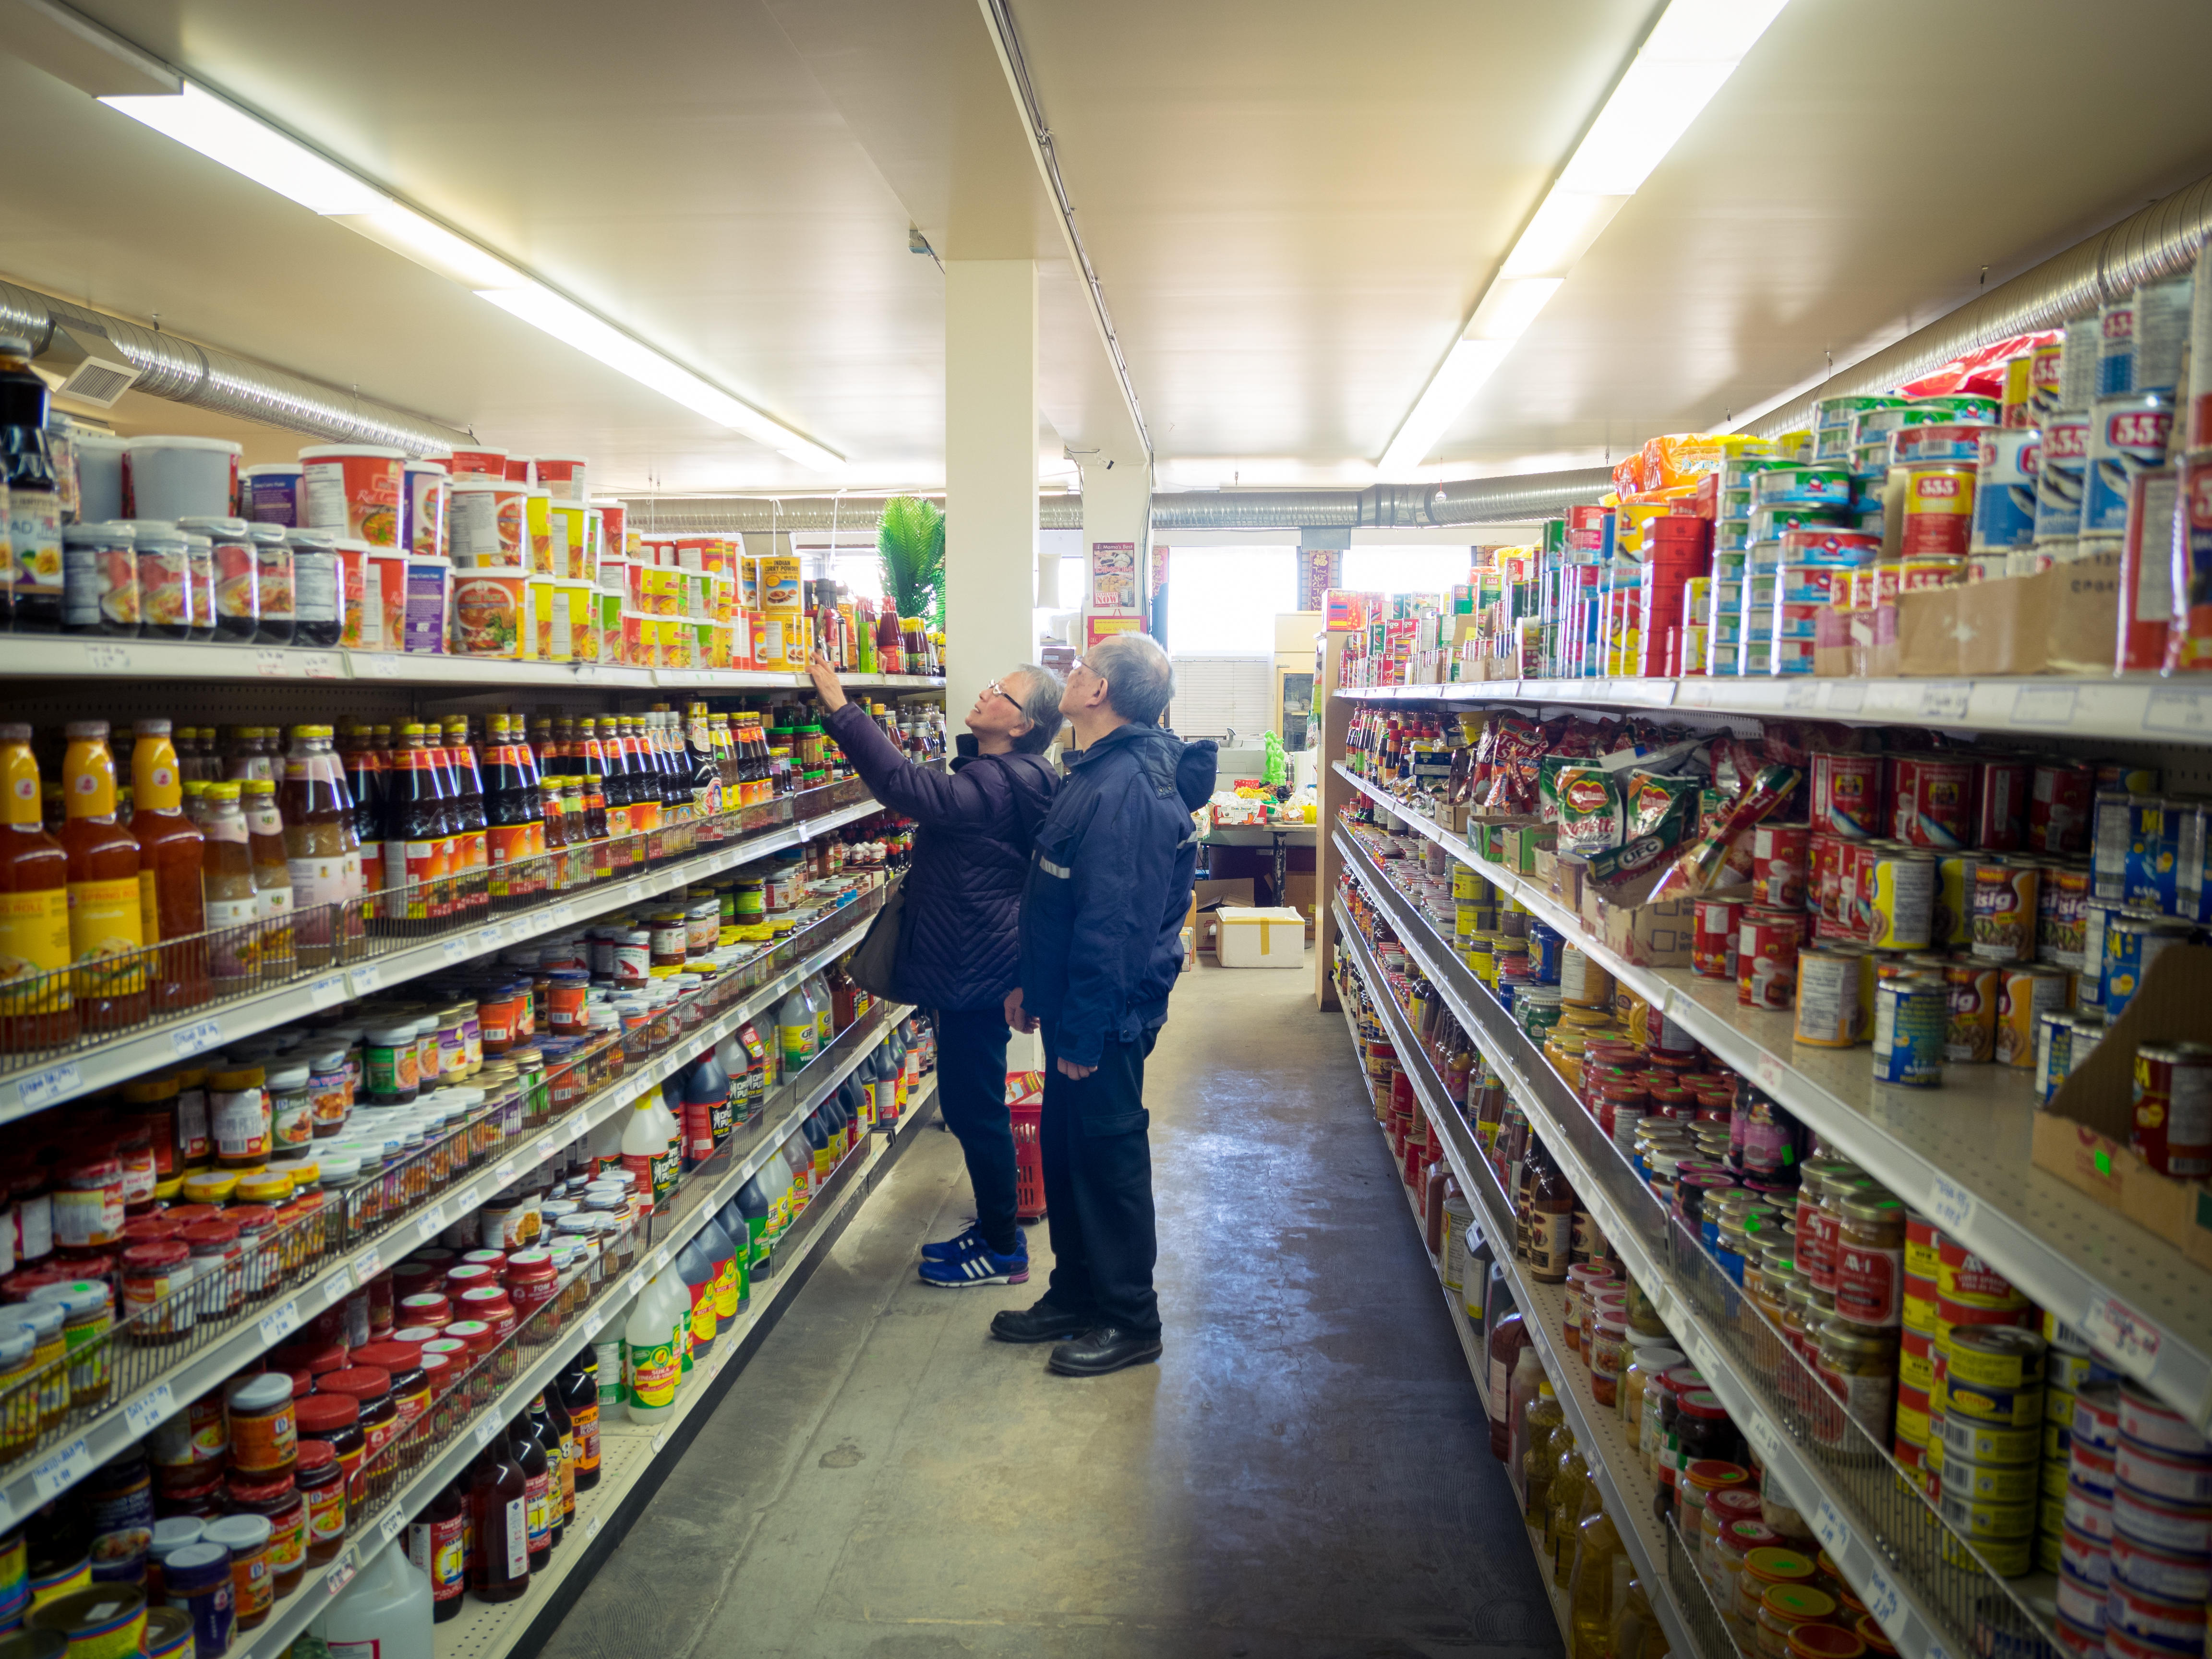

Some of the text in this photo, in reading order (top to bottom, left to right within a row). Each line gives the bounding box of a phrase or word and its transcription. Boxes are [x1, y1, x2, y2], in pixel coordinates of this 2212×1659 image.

[1922, 480, 1954, 495] 555
[1455, 586, 1467, 594] 555
[1096, 596, 1118, 604] NOW
[1559, 817, 1616, 840] paghetti
[1624, 842, 1658, 864] UFC
[1450, 1215, 1469, 1224] Nutrition
[533, 1283, 550, 1291] TOM
[574, 1416, 591, 1425] DATU
